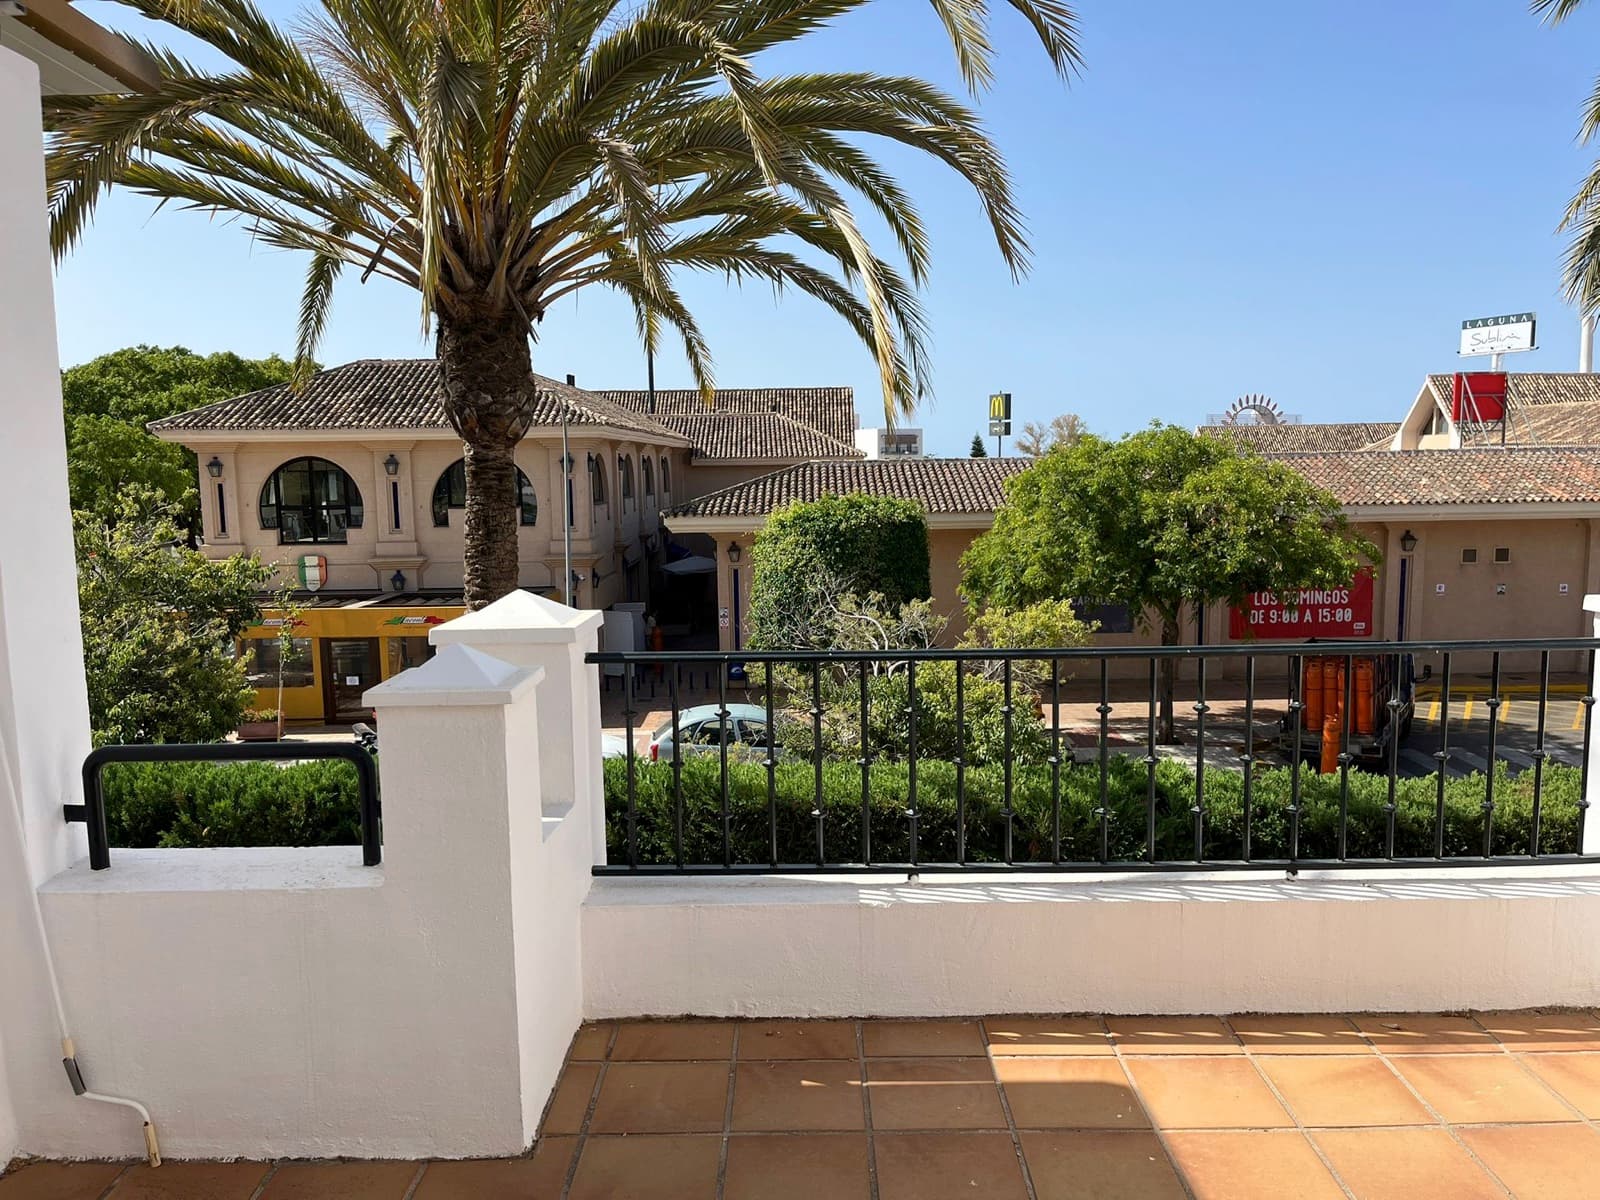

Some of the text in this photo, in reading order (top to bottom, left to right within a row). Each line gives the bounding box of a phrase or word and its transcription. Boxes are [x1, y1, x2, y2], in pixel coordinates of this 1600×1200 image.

[1466, 314, 1528, 329] LAGUNA
[1254, 591, 1278, 606] LOS
[1250, 607, 1352, 624] DE 9:00 A 15:00
